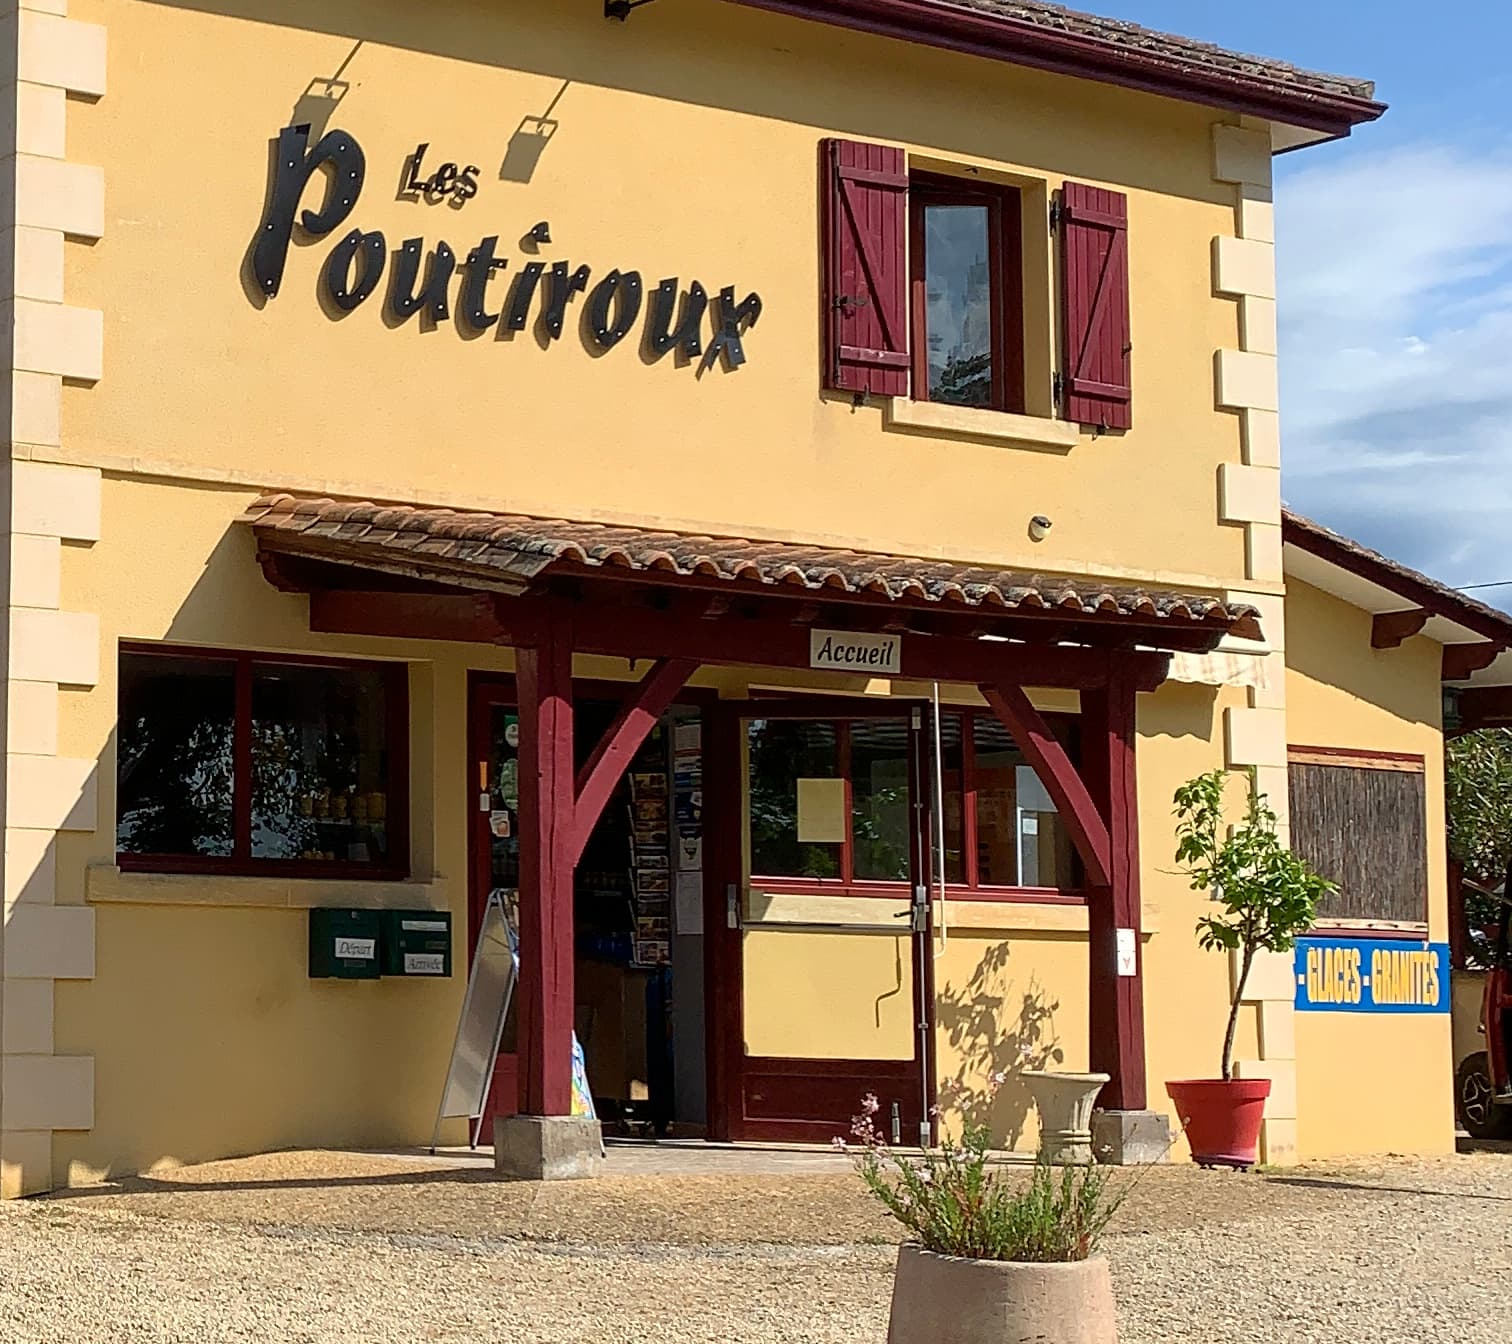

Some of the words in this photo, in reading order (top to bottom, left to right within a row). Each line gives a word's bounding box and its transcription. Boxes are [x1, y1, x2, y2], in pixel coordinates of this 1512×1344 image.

[405, 142, 480, 200] Les
[251, 122, 763, 374] Poutiroux
[817, 636, 894, 666] Accueil
[1307, 946, 1362, 1004] GLACES
